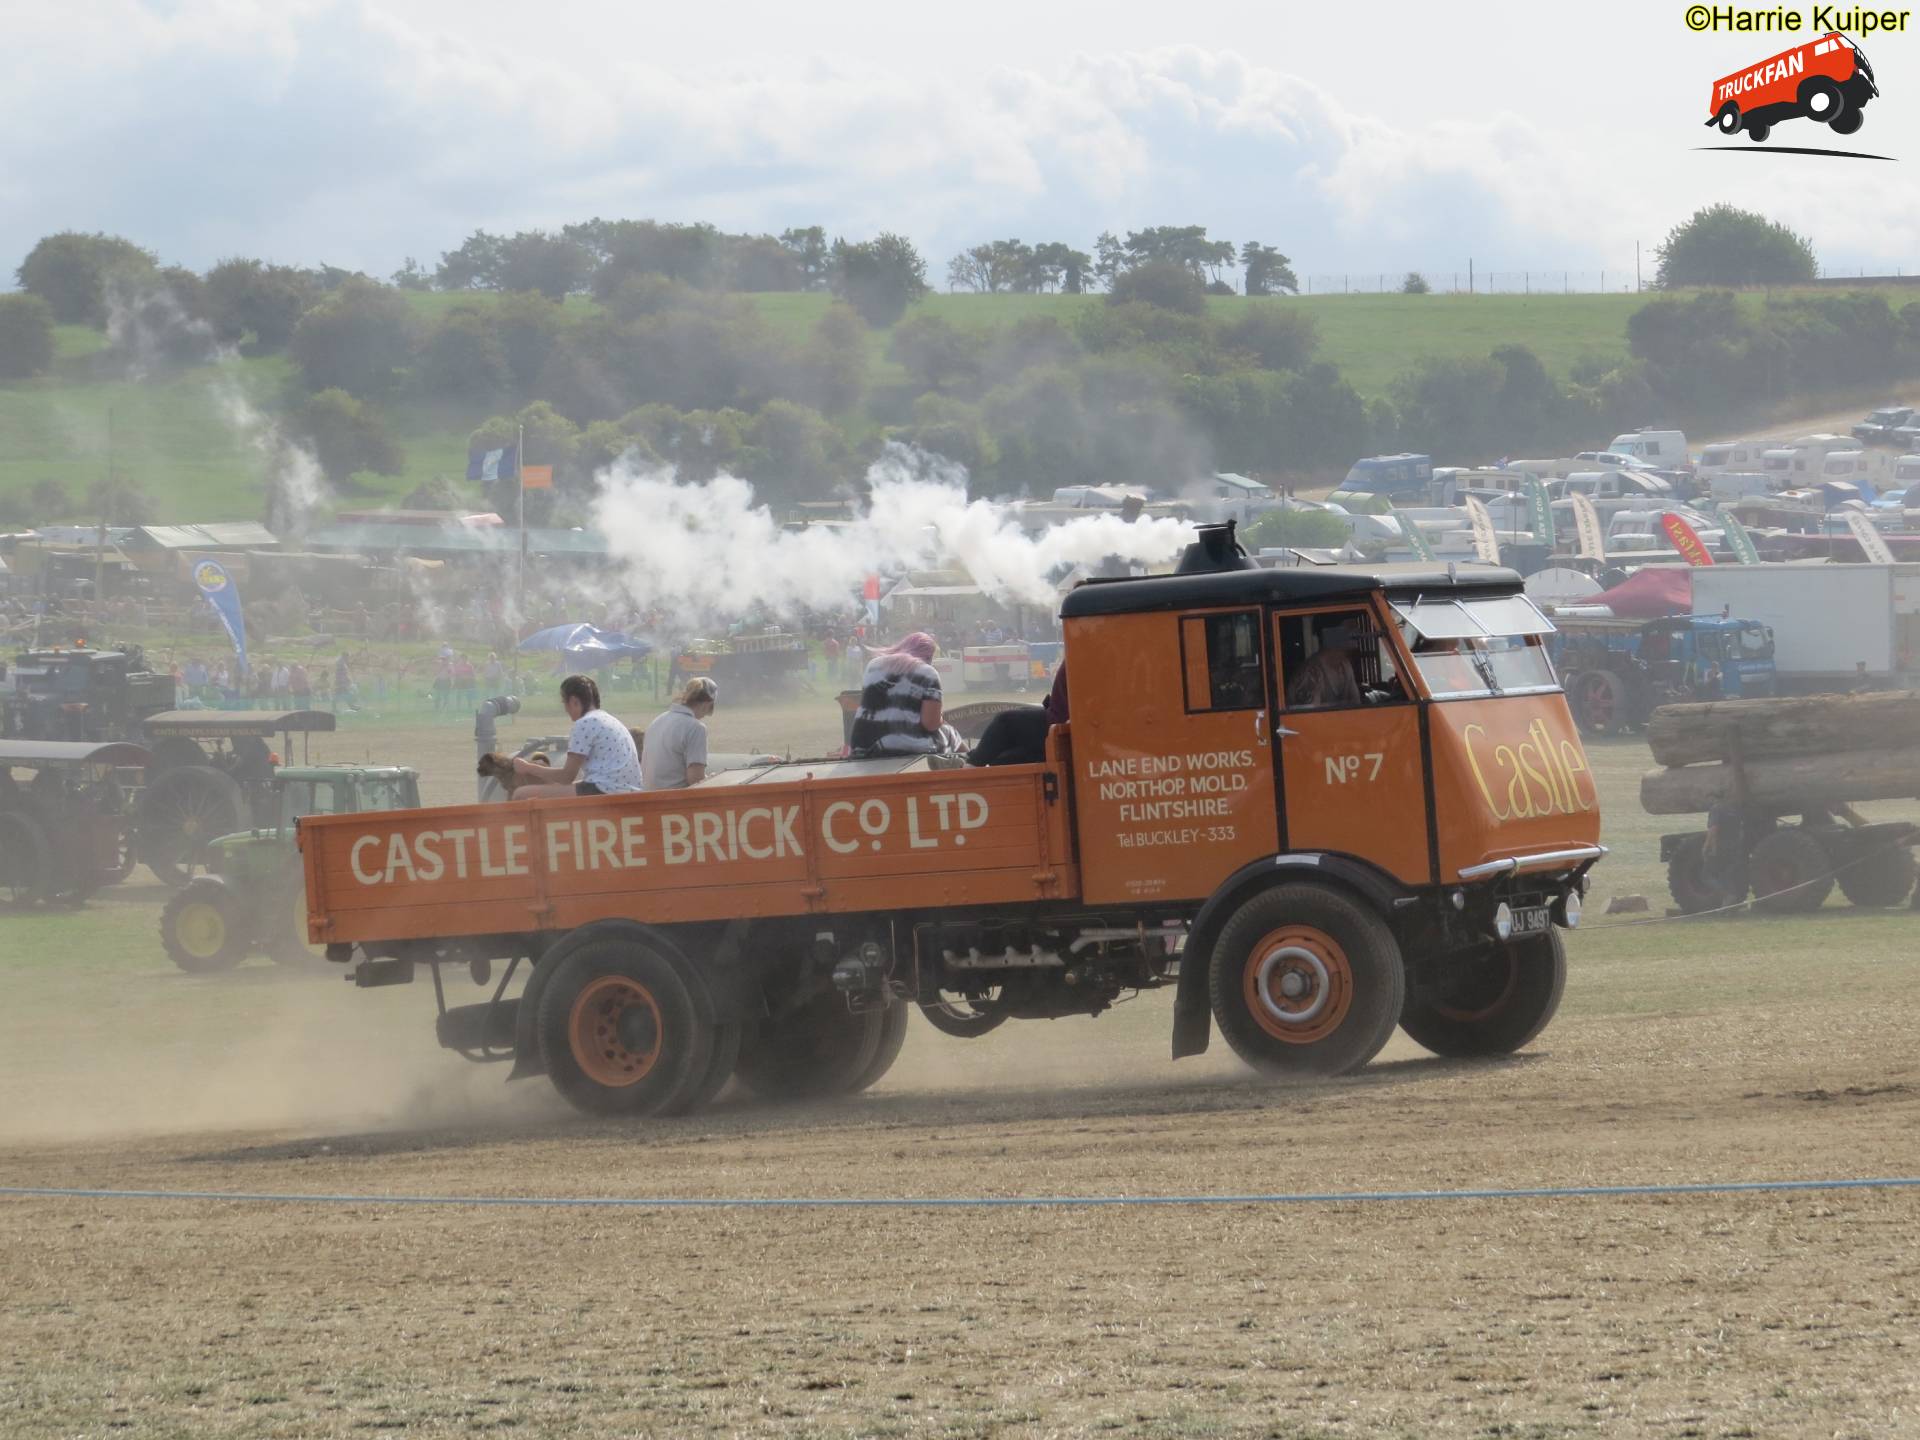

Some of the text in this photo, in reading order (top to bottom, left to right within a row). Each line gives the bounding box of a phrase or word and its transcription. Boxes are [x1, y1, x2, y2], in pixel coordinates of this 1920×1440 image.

[1089, 760, 1137, 778] LANE
[1141, 755, 1181, 774] END
[1365, 753, 1384, 782] 7
[1464, 718, 1593, 821] Castle
[350, 824, 530, 885] CASTLE
[545, 816, 648, 872] FIRE
[661, 803, 804, 864] BRICK
[1527, 909, 1550, 930] 9497
